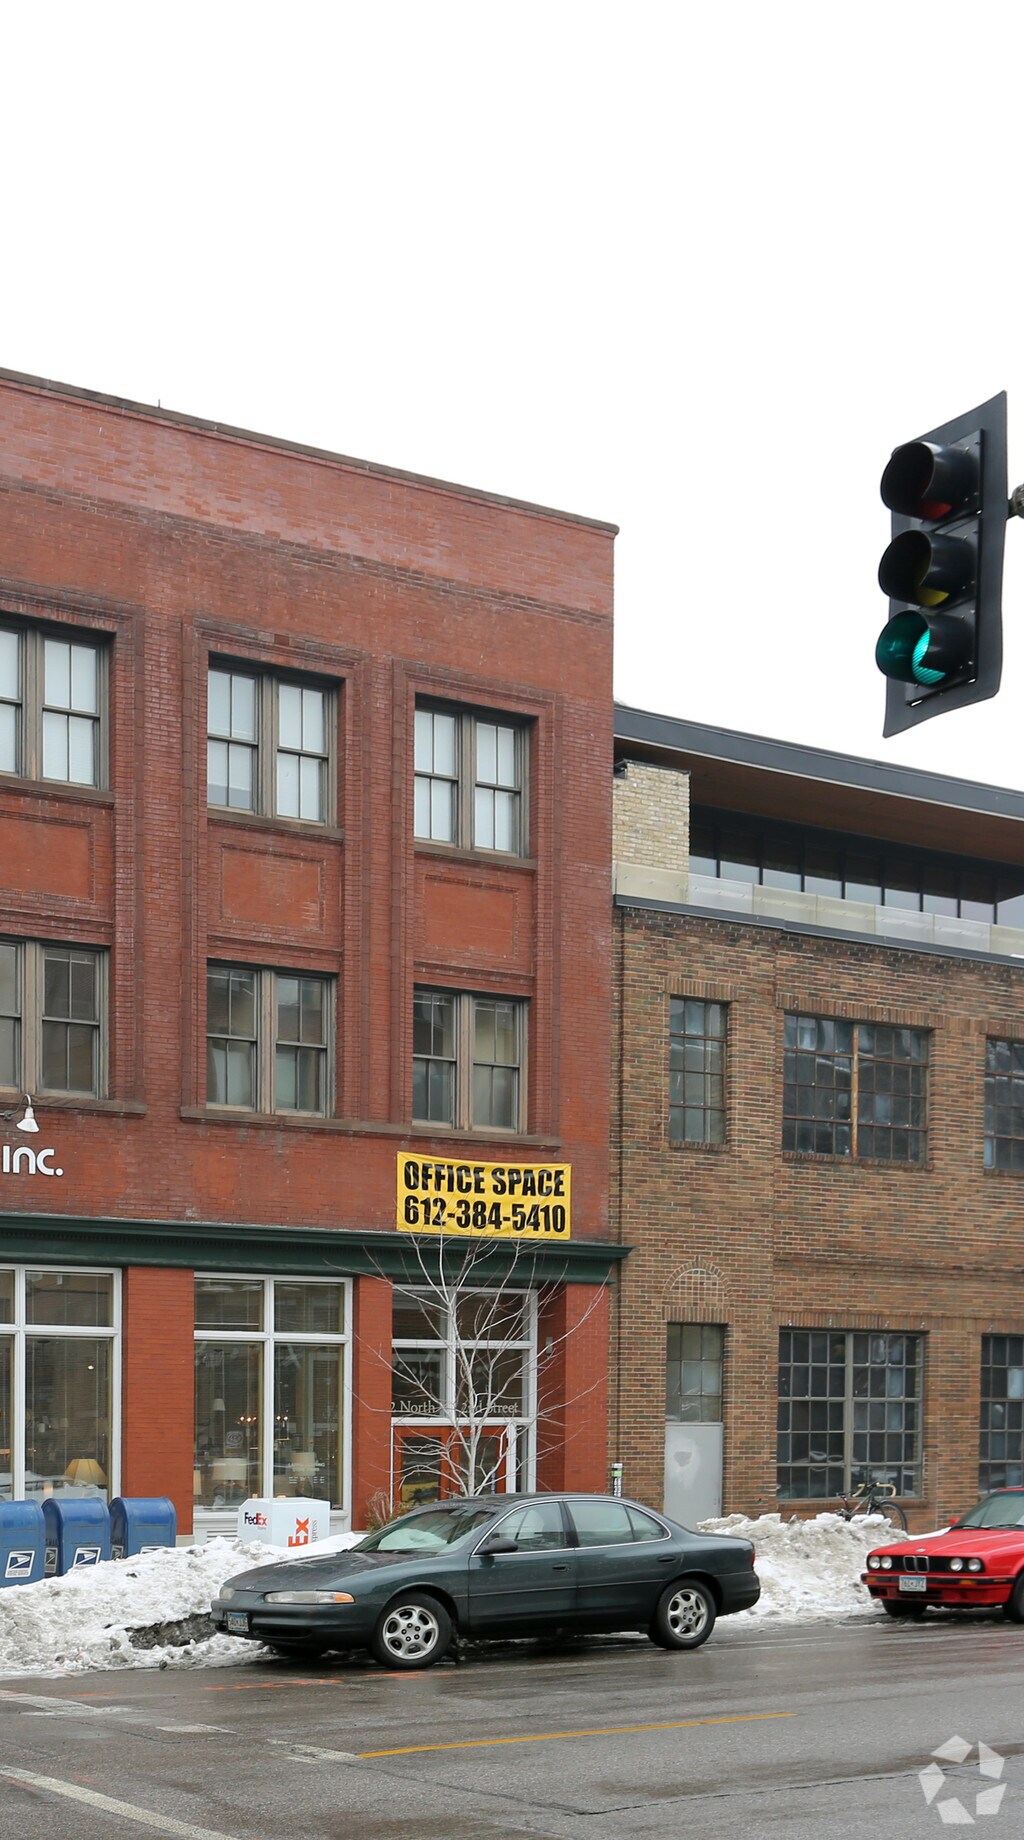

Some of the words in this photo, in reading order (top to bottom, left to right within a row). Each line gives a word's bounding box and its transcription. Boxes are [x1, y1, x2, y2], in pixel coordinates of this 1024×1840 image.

[404, 1160, 486, 1194] OFFICE
[491, 1167, 565, 1197] SPACE
[404, 1195, 566, 1233] 612-384-5410
[400, 1400, 435, 1413] North
[462, 1400, 482, 1413] 2d
[244, 1512, 268, 1526] FedEx
